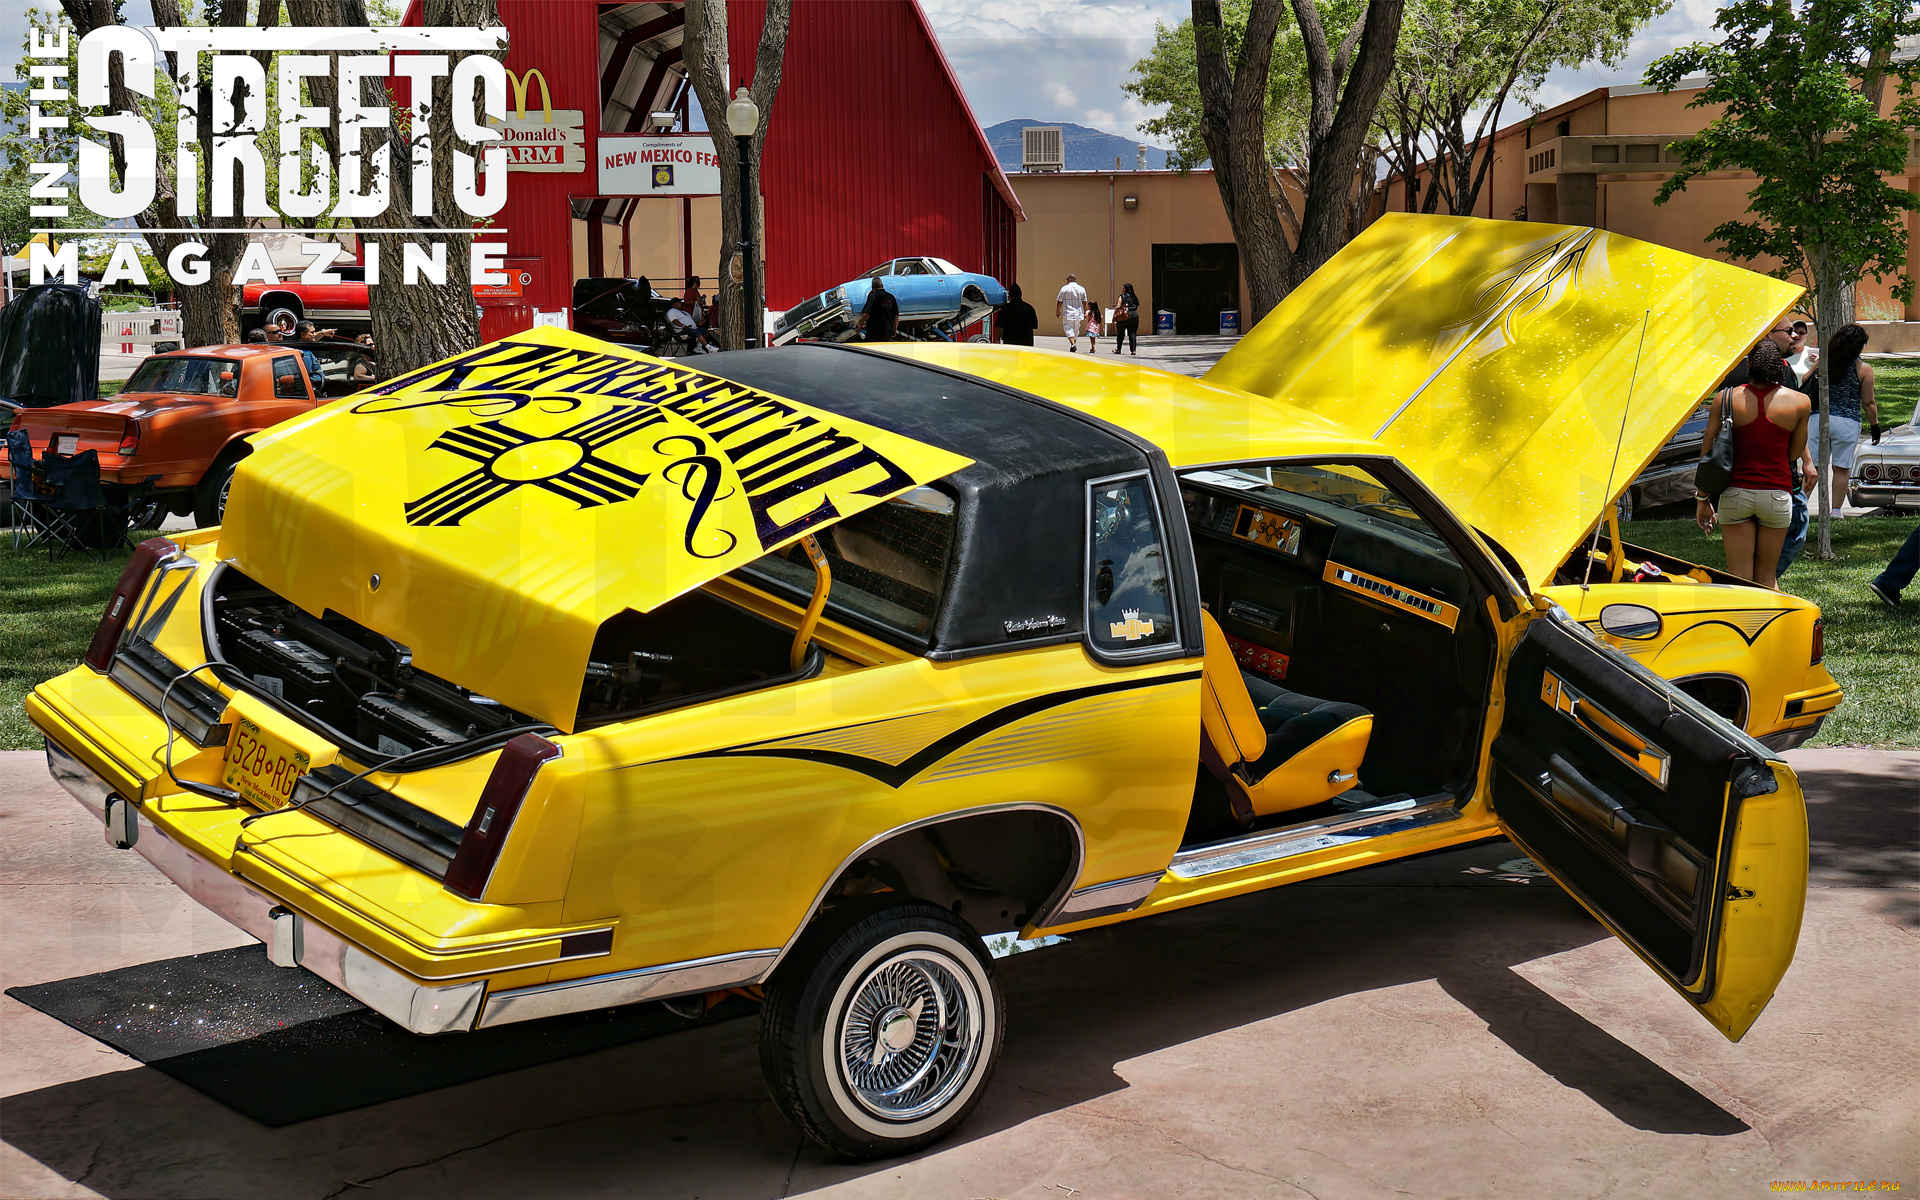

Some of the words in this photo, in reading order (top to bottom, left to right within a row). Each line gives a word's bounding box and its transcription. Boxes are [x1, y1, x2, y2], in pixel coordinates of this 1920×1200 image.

[506, 146, 558, 163] ARM
[605, 150, 637, 170] NEW
[640, 149, 693, 164] MEXICO
[696, 151, 721, 168] FFA
[240, 775, 252, 788] New
[252, 782, 272, 801] Mexico
[272, 796, 284, 808] USA
